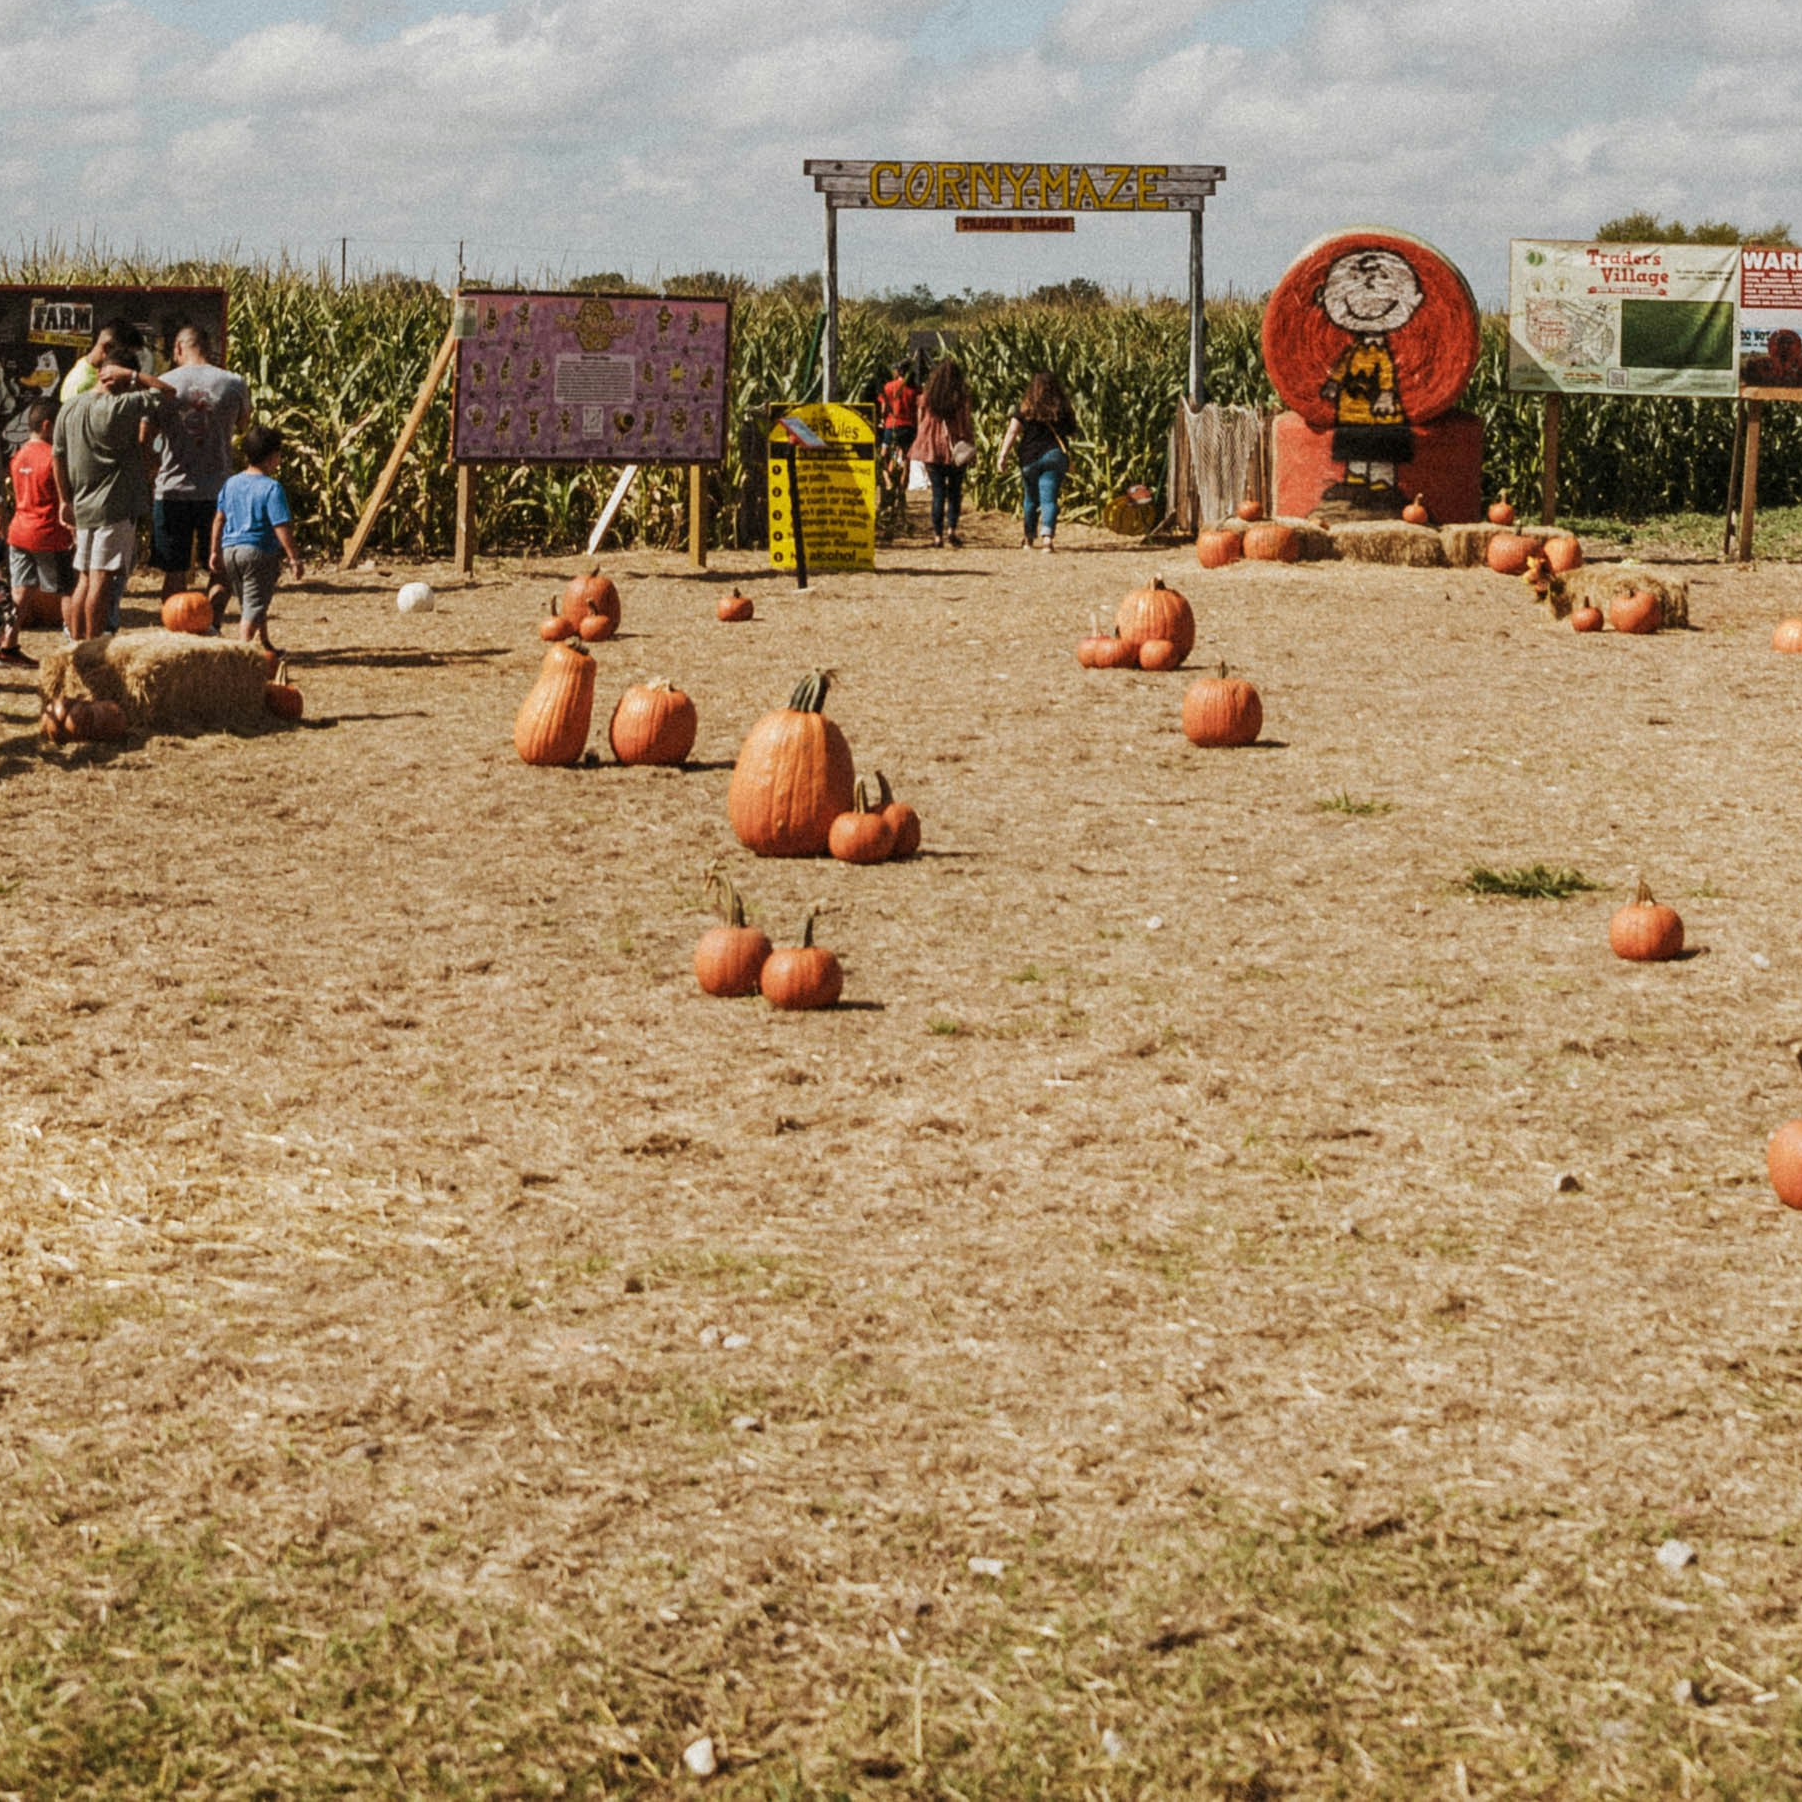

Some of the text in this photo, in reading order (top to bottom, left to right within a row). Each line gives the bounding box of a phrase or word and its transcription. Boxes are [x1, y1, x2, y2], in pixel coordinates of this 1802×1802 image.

[870, 161, 1169, 210] CORNY-MAZE
[1601, 267, 1669, 286] Village
[34, 305, 91, 330] FARM
[823, 419, 859, 439] Rules
